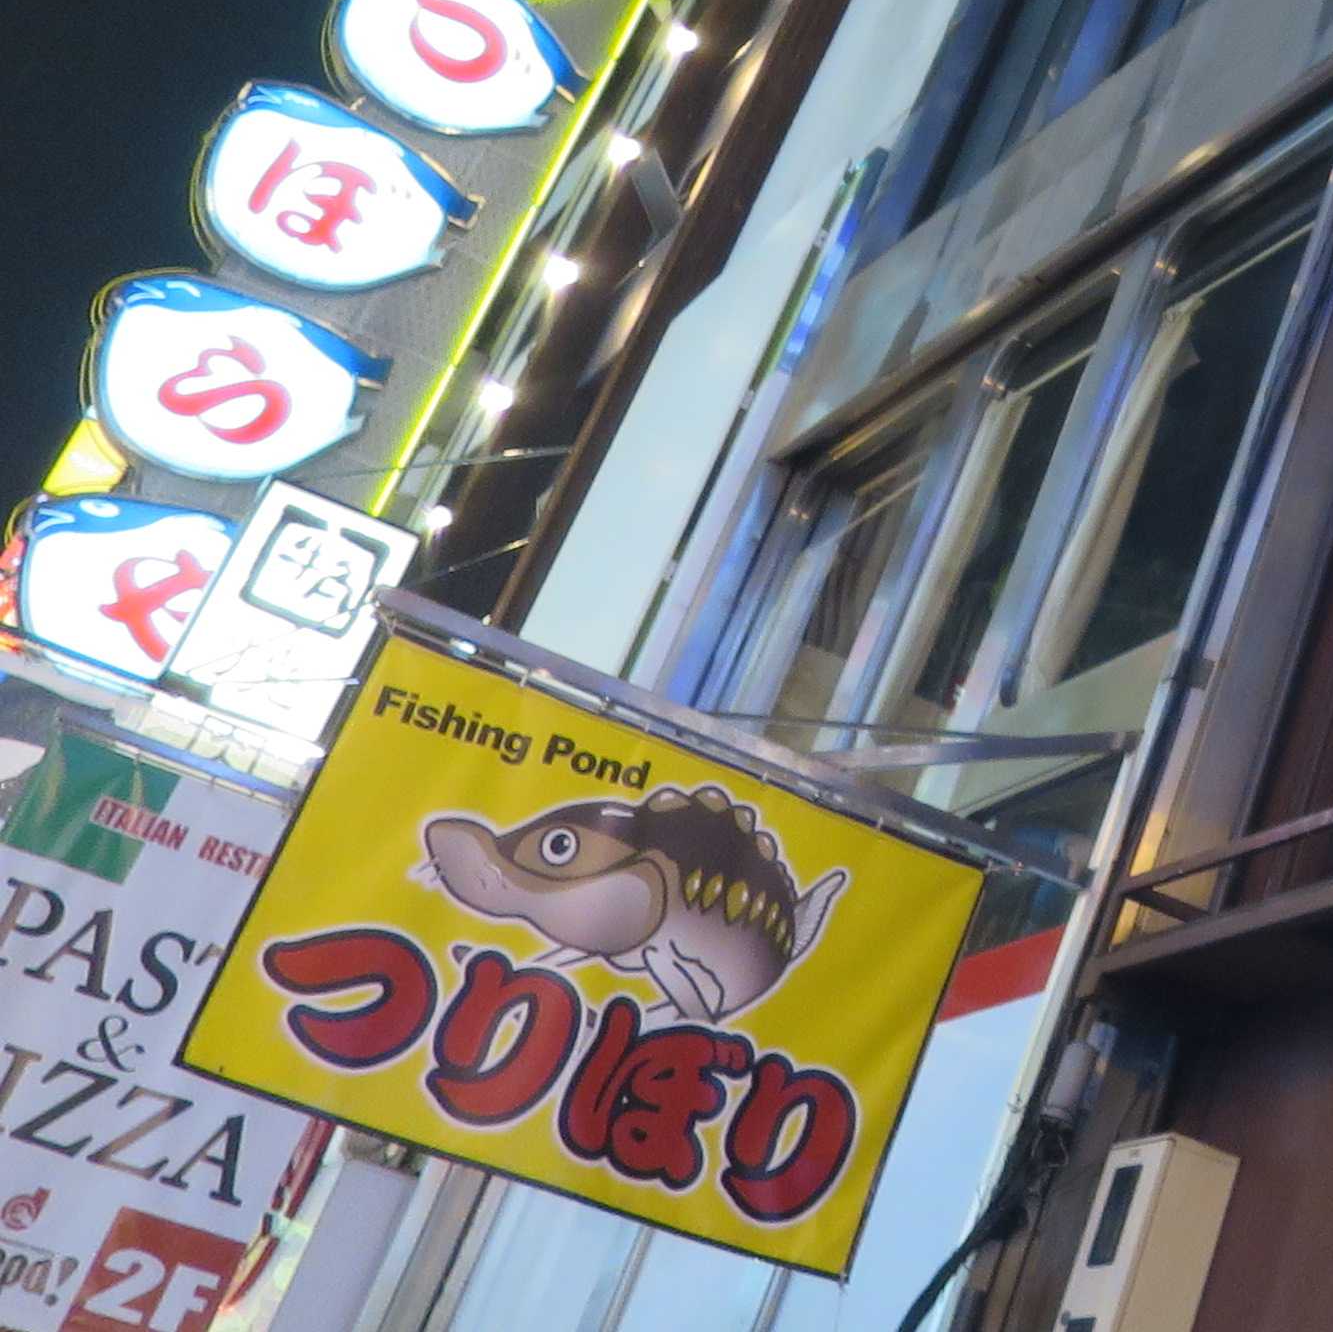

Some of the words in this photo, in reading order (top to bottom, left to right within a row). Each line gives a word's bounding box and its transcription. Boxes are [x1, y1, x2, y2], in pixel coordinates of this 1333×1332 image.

[373, 684, 533, 765] Fishing
[542, 733, 652, 790] Pond
[93, 797, 189, 851] ITALIAN
[0, 877, 223, 1017] PAS
[76, 1014, 146, 1073] &
[262, 928, 857, 1225] つりぼり
[83, 1247, 222, 1332] 2F
